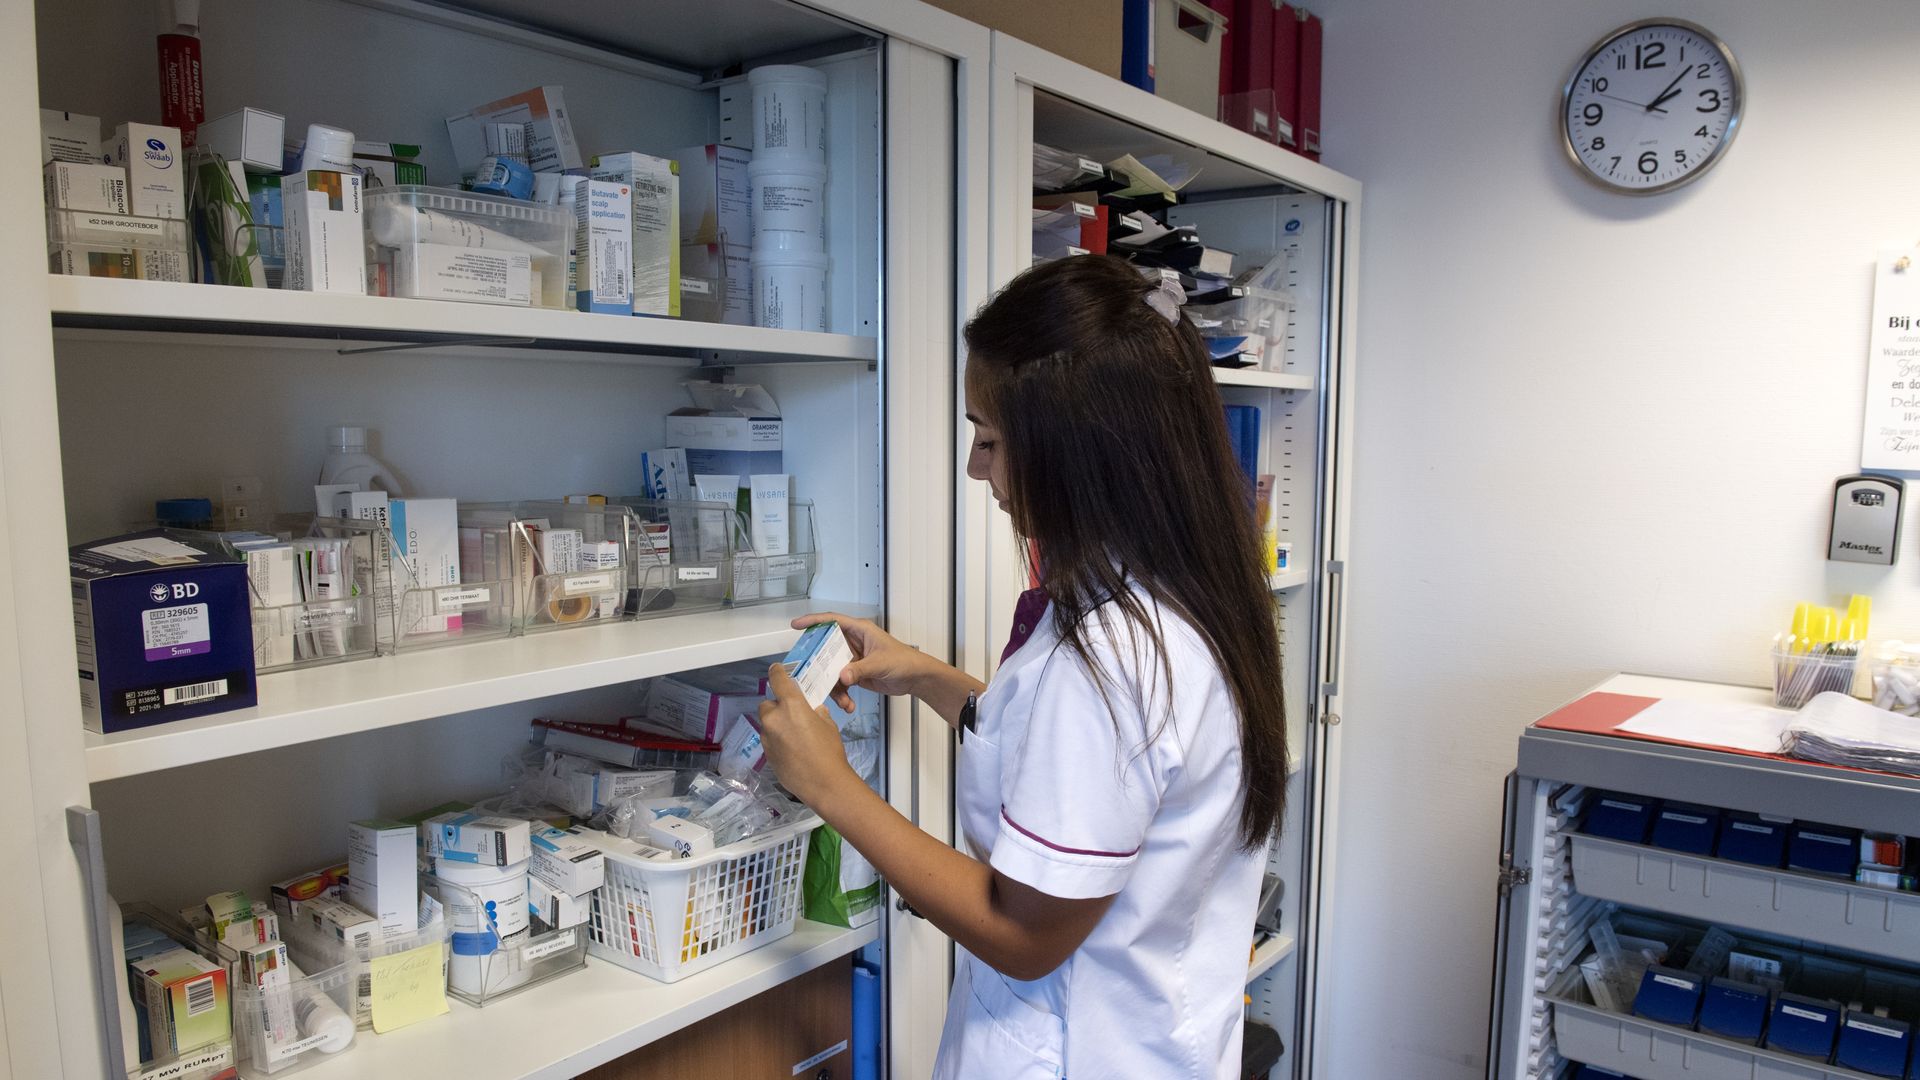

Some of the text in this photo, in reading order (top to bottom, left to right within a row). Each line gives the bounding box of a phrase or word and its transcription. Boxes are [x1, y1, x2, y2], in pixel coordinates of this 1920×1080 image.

[1635, 42, 1666, 70] 12
[1680, 46, 1684, 62] 1
[1617, 54, 1626, 70] 11
[1697, 63, 1710, 79] 2
[169, 62, 179, 105] Applicator
[1592, 77, 1608, 93] 10
[1696, 89, 1721, 113] 3
[1583, 103, 1603, 126] 9
[1694, 125, 1708, 138] 4
[1591, 137, 1605, 151] 8
[144, 151, 170, 161] Swaab
[1611, 156, 1622, 169] 7
[1675, 150, 1686, 163] 5
[1638, 151, 1659, 175] 6
[591, 200, 608, 208] scalp
[591, 210, 625, 219] application
[116, 221, 159, 229] GROOTEBOER
[122, 257, 131, 266] 10
[1889, 316, 1910, 331] Bij
[1892, 381, 1904, 389] en
[1839, 541, 1883, 552] Master
[172, 582, 199, 599] BD
[167, 607, 198, 617] 329605
[172, 647, 191, 656] 5mm
[137, 689, 156, 697] 329605
[159, 1066, 181, 1079] MW
